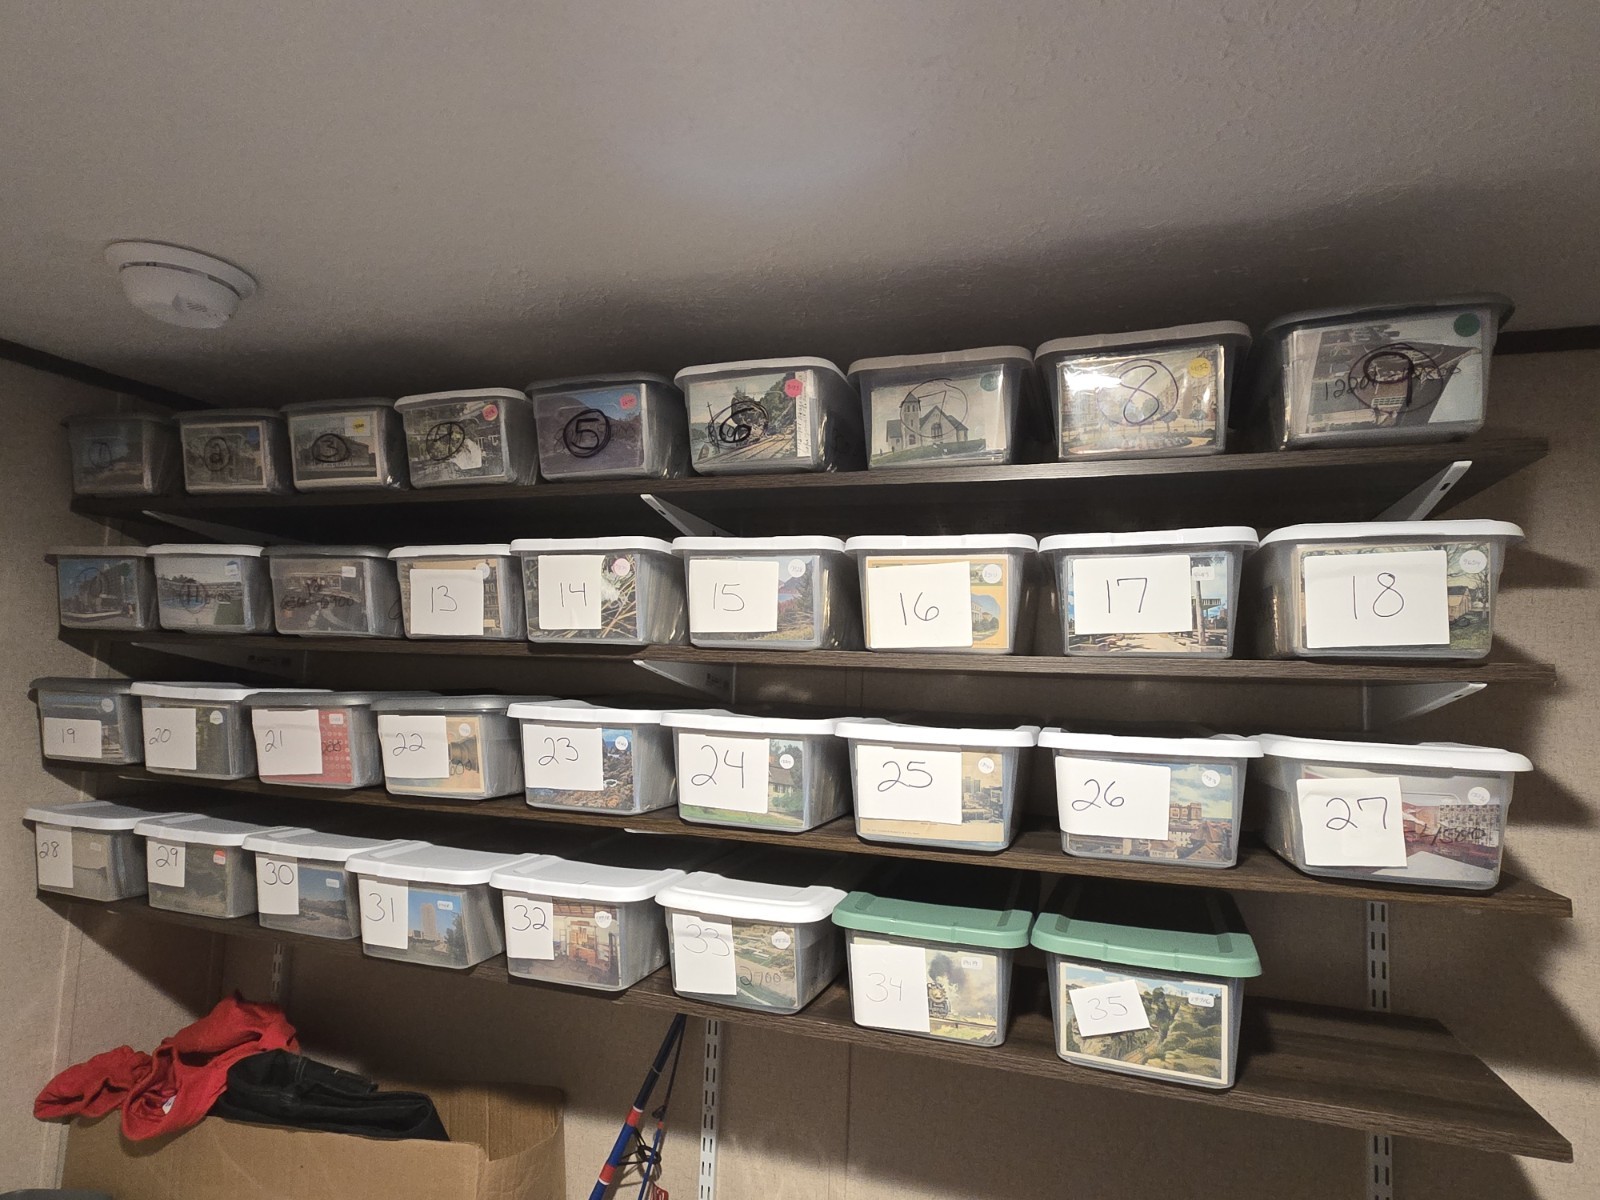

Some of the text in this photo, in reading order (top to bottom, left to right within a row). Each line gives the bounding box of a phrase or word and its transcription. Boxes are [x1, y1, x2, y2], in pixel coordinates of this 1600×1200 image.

[431, 585, 457, 613] 13
[560, 583, 587, 607] 14
[713, 583, 744, 611] 15
[900, 592, 939, 625] 16
[1106, 578, 1147, 613] 17
[1353, 572, 1404, 619] 18
[62, 728, 75, 743] 19
[148, 726, 171, 745] 20
[265, 730, 282, 752] 21
[393, 733, 427, 756] 22
[538, 737, 578, 766] 23
[691, 744, 745, 789] 24
[878, 761, 933, 792] 25
[1072, 779, 1124, 811] 26
[1326, 797, 1387, 830] 27
[39, 841, 60, 859] 28
[155, 845, 178, 866] 29
[264, 861, 294, 885] 30
[365, 892, 395, 922] 31
[511, 904, 551, 932] 32
[683, 923, 731, 956] 33
[865, 972, 903, 1003] 34
[1089, 995, 1127, 1021] 35
